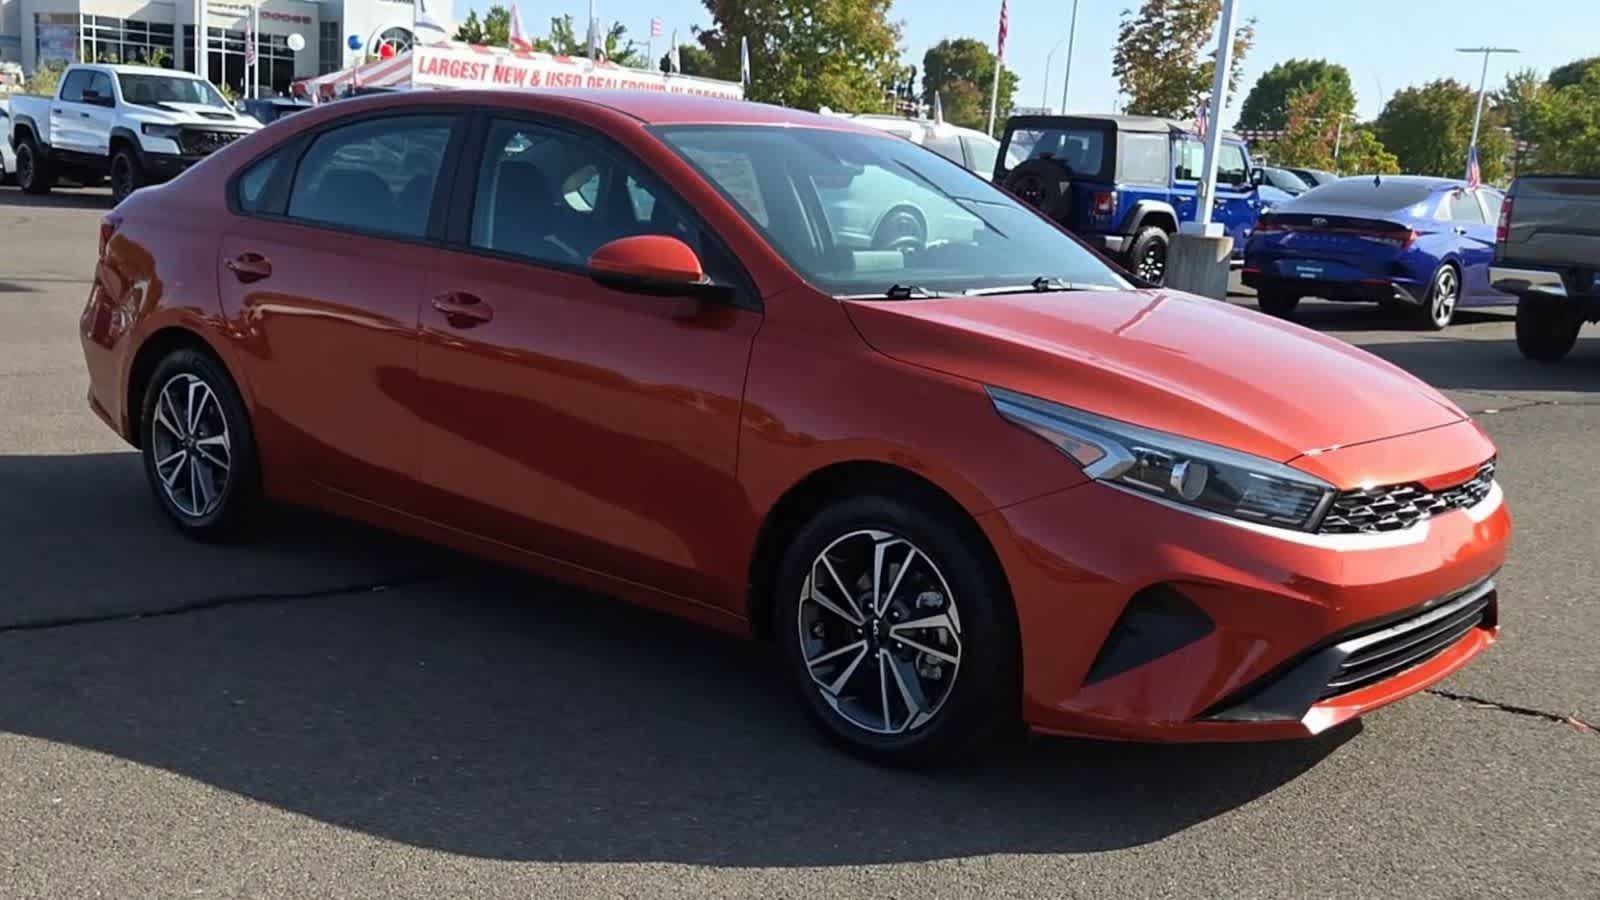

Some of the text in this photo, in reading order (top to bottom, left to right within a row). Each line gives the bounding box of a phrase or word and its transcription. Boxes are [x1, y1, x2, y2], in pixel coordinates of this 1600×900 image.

[418, 55, 490, 82] LARGEST
[493, 64, 528, 86] NEW
[530, 69, 541, 87] &
[545, 71, 583, 88] USED
